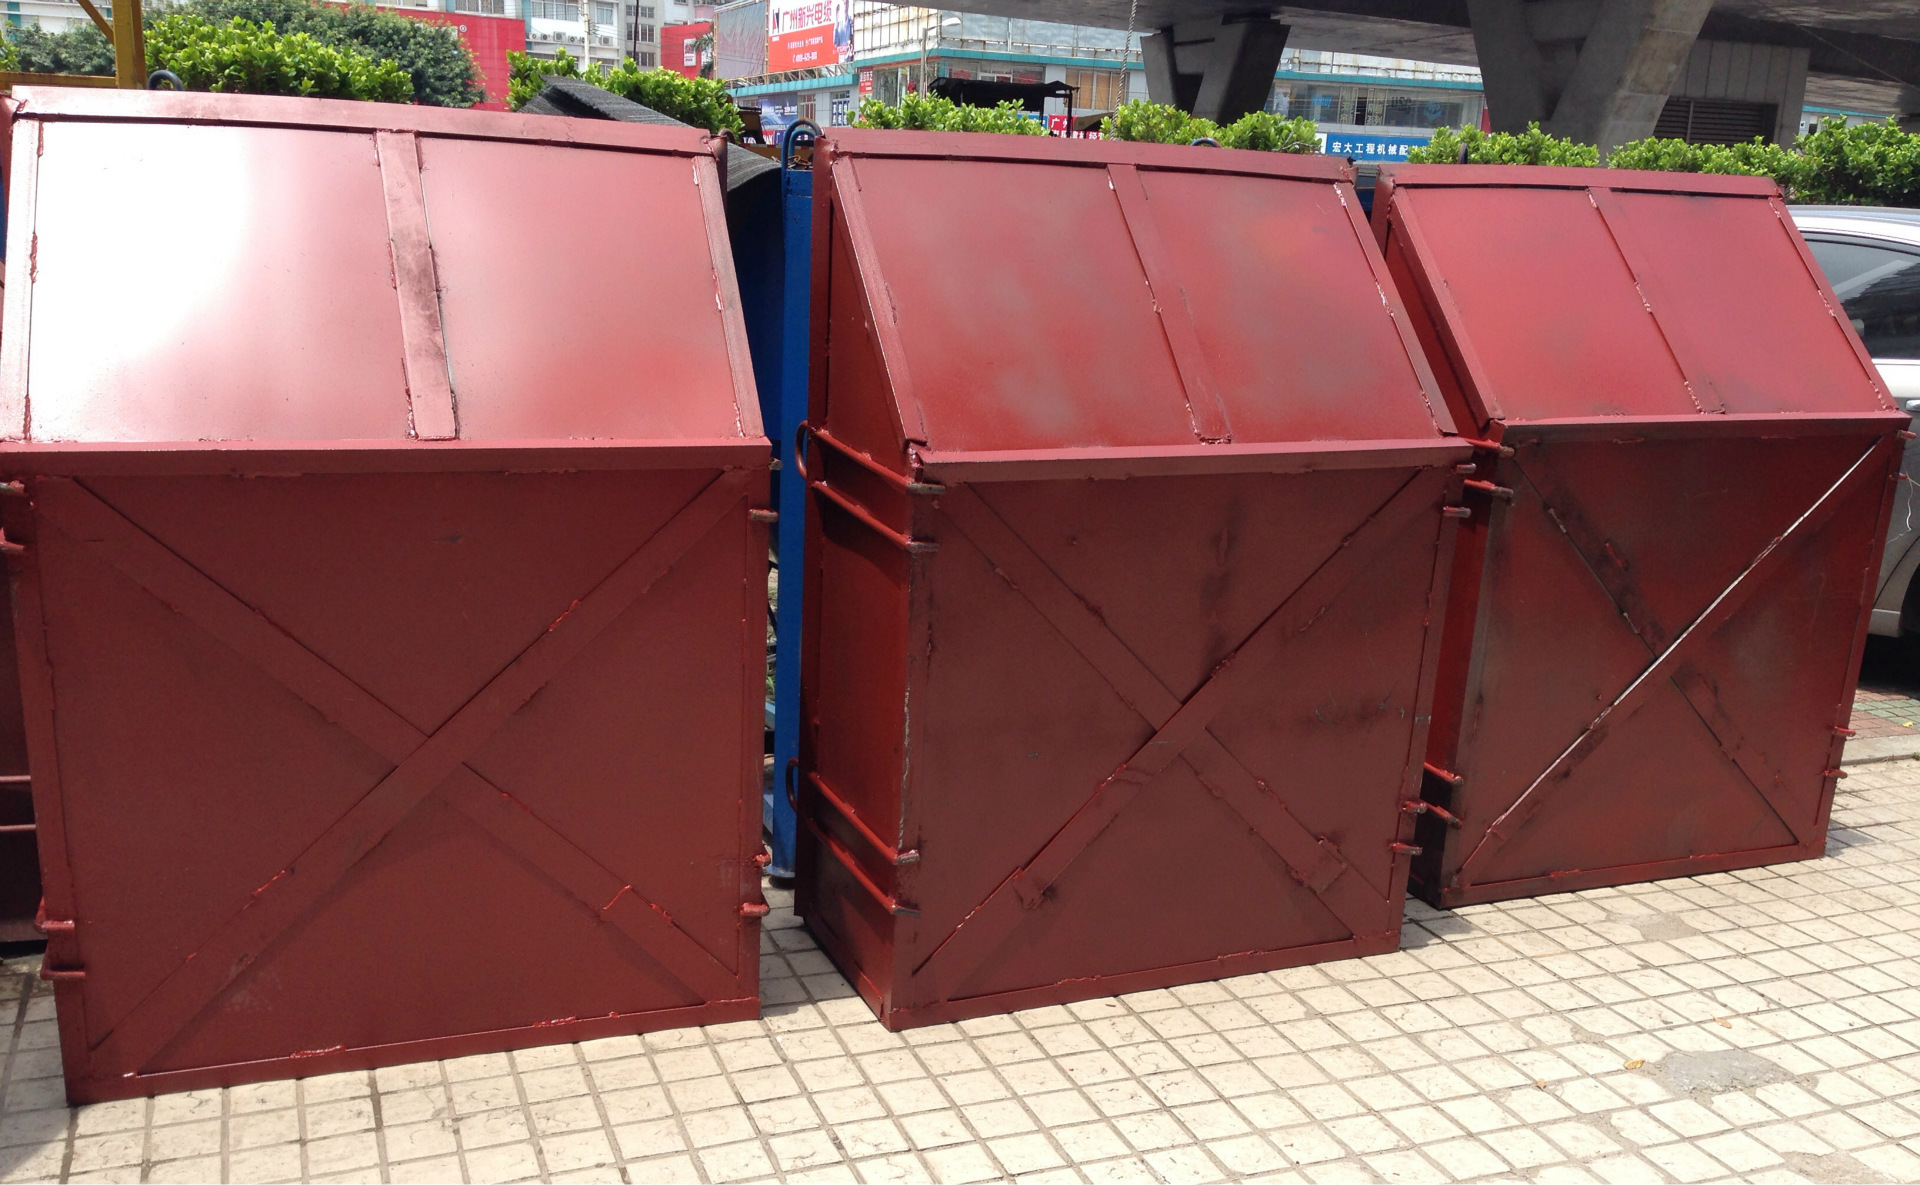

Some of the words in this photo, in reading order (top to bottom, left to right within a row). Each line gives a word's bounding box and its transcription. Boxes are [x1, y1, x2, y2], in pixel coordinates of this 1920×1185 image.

[782, 0, 832, 32] 广州新兴电缆
